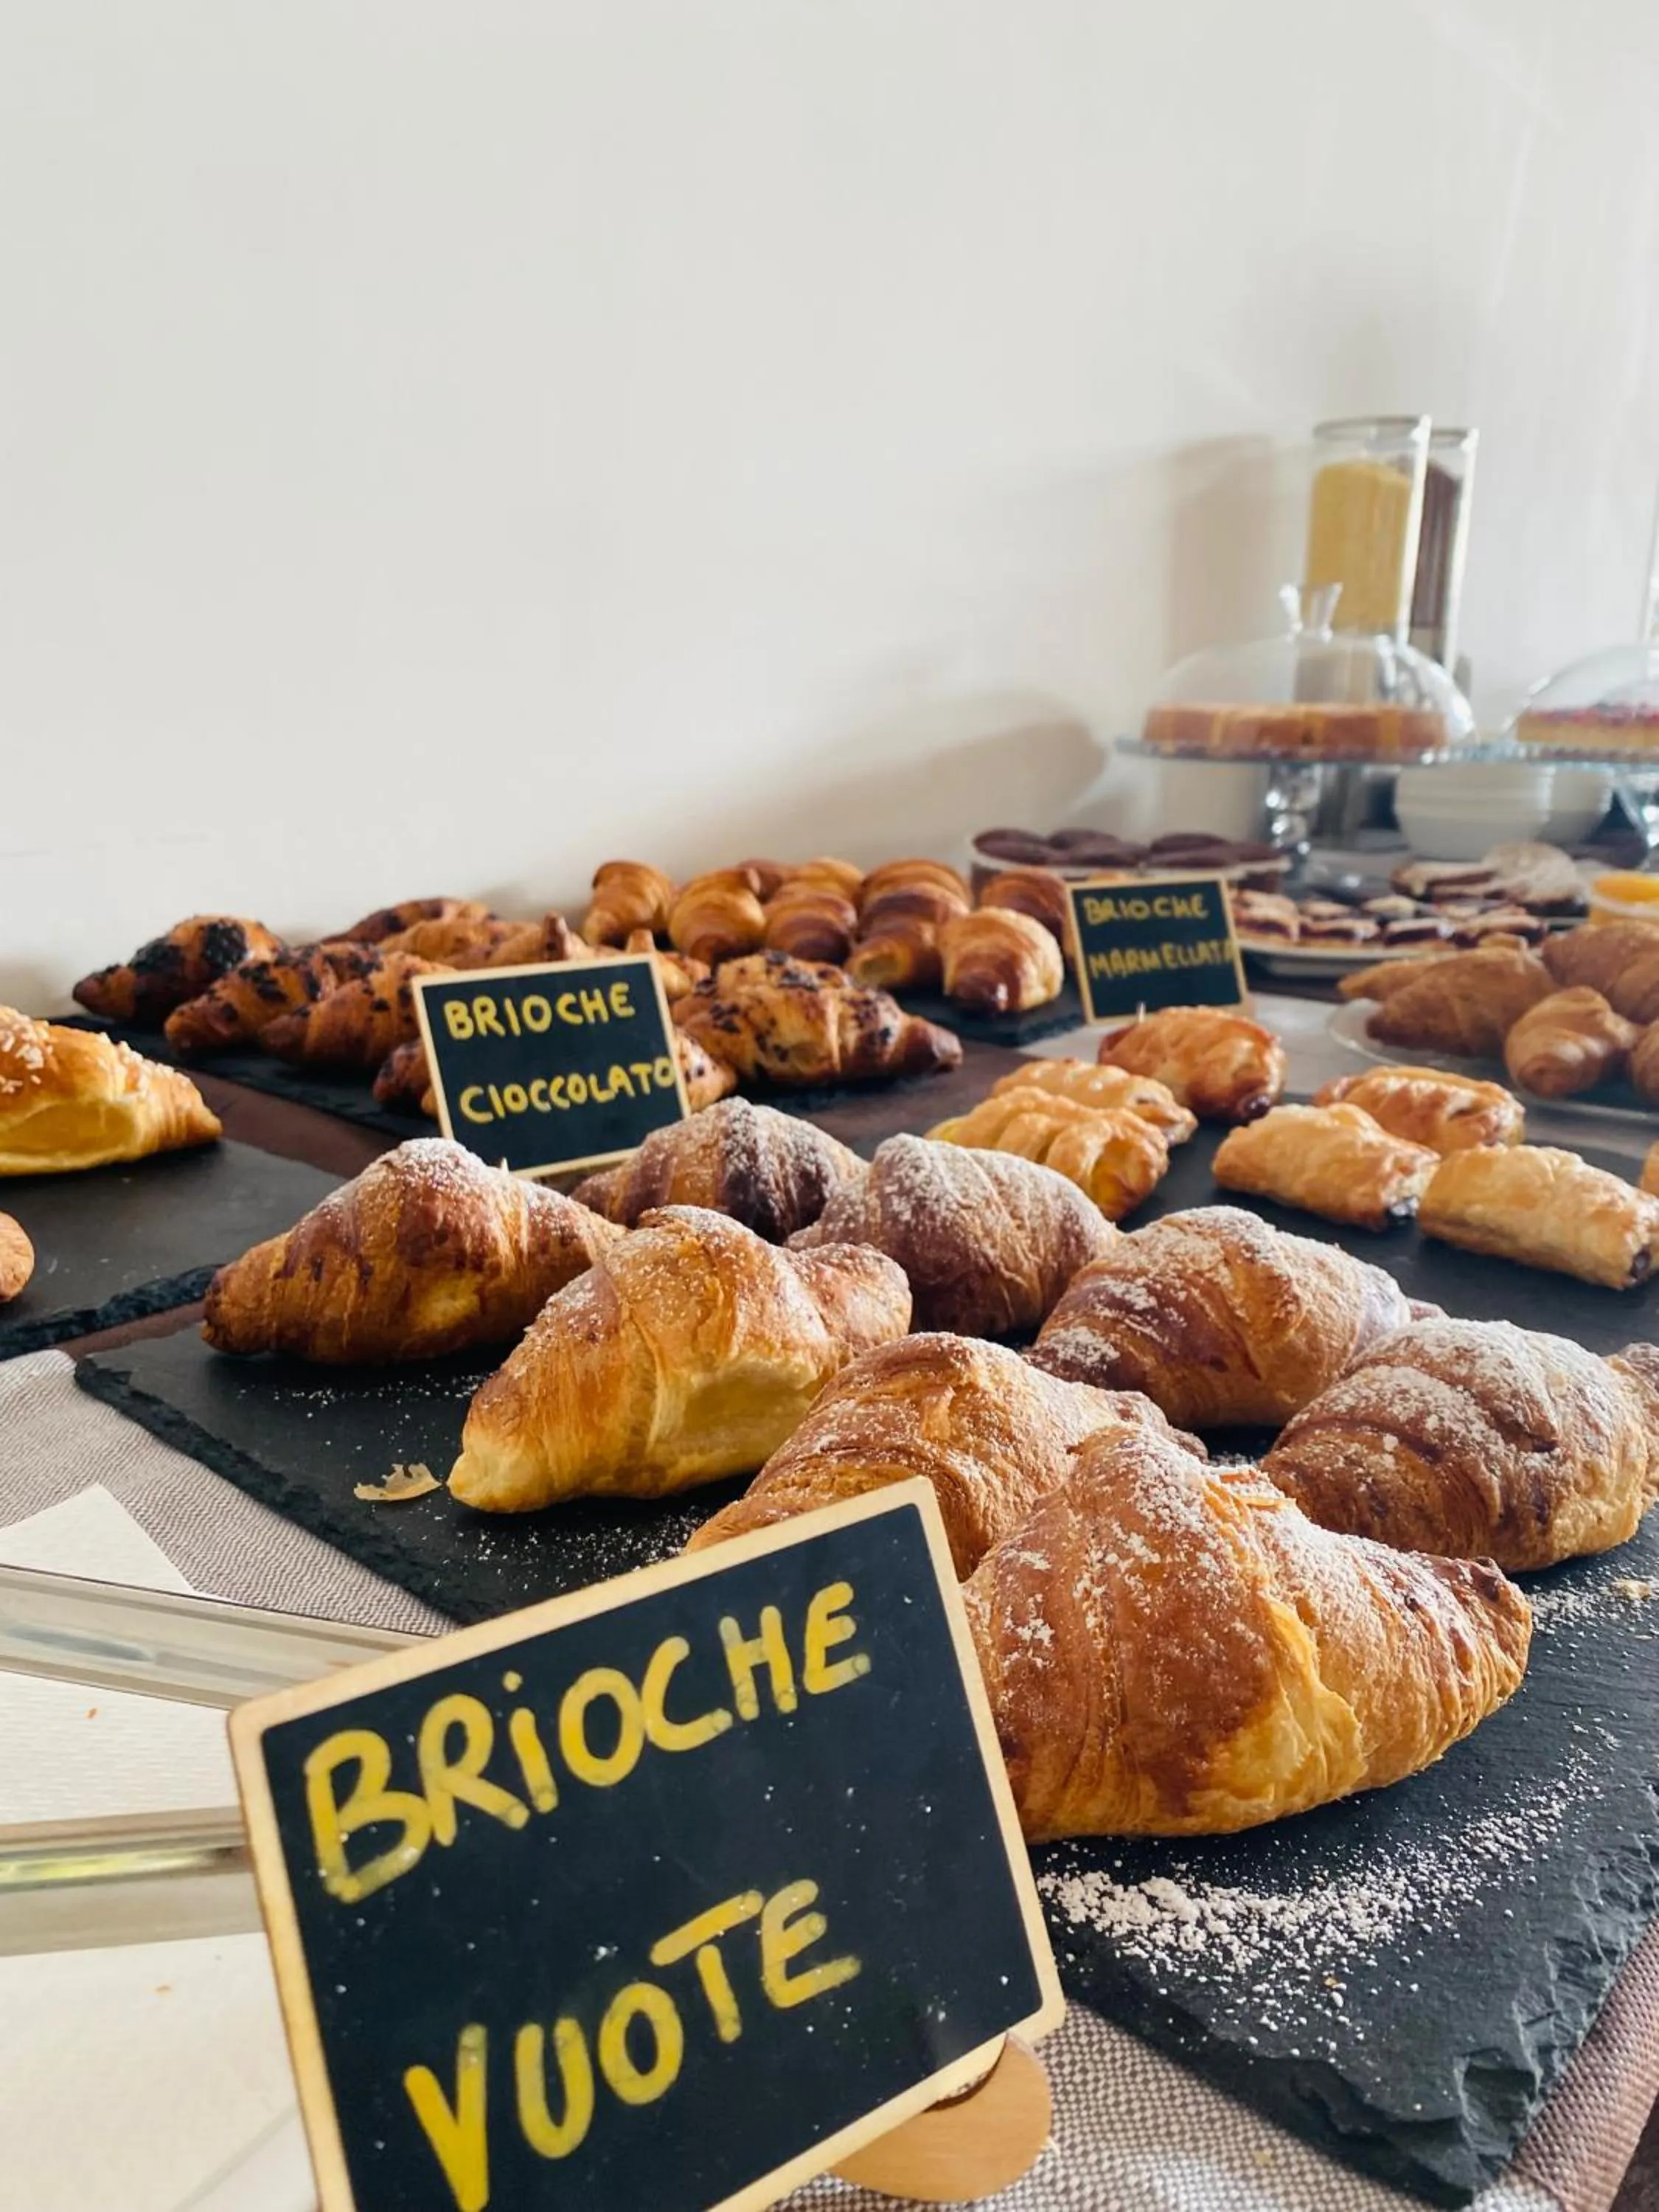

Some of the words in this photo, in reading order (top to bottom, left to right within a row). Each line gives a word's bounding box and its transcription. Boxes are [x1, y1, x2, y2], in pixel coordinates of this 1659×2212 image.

[444, 981, 635, 1040] BRIOCHE
[459, 1056, 676, 1124] CIOCCOLATO
[403, 1879, 862, 2212] VUOTE
